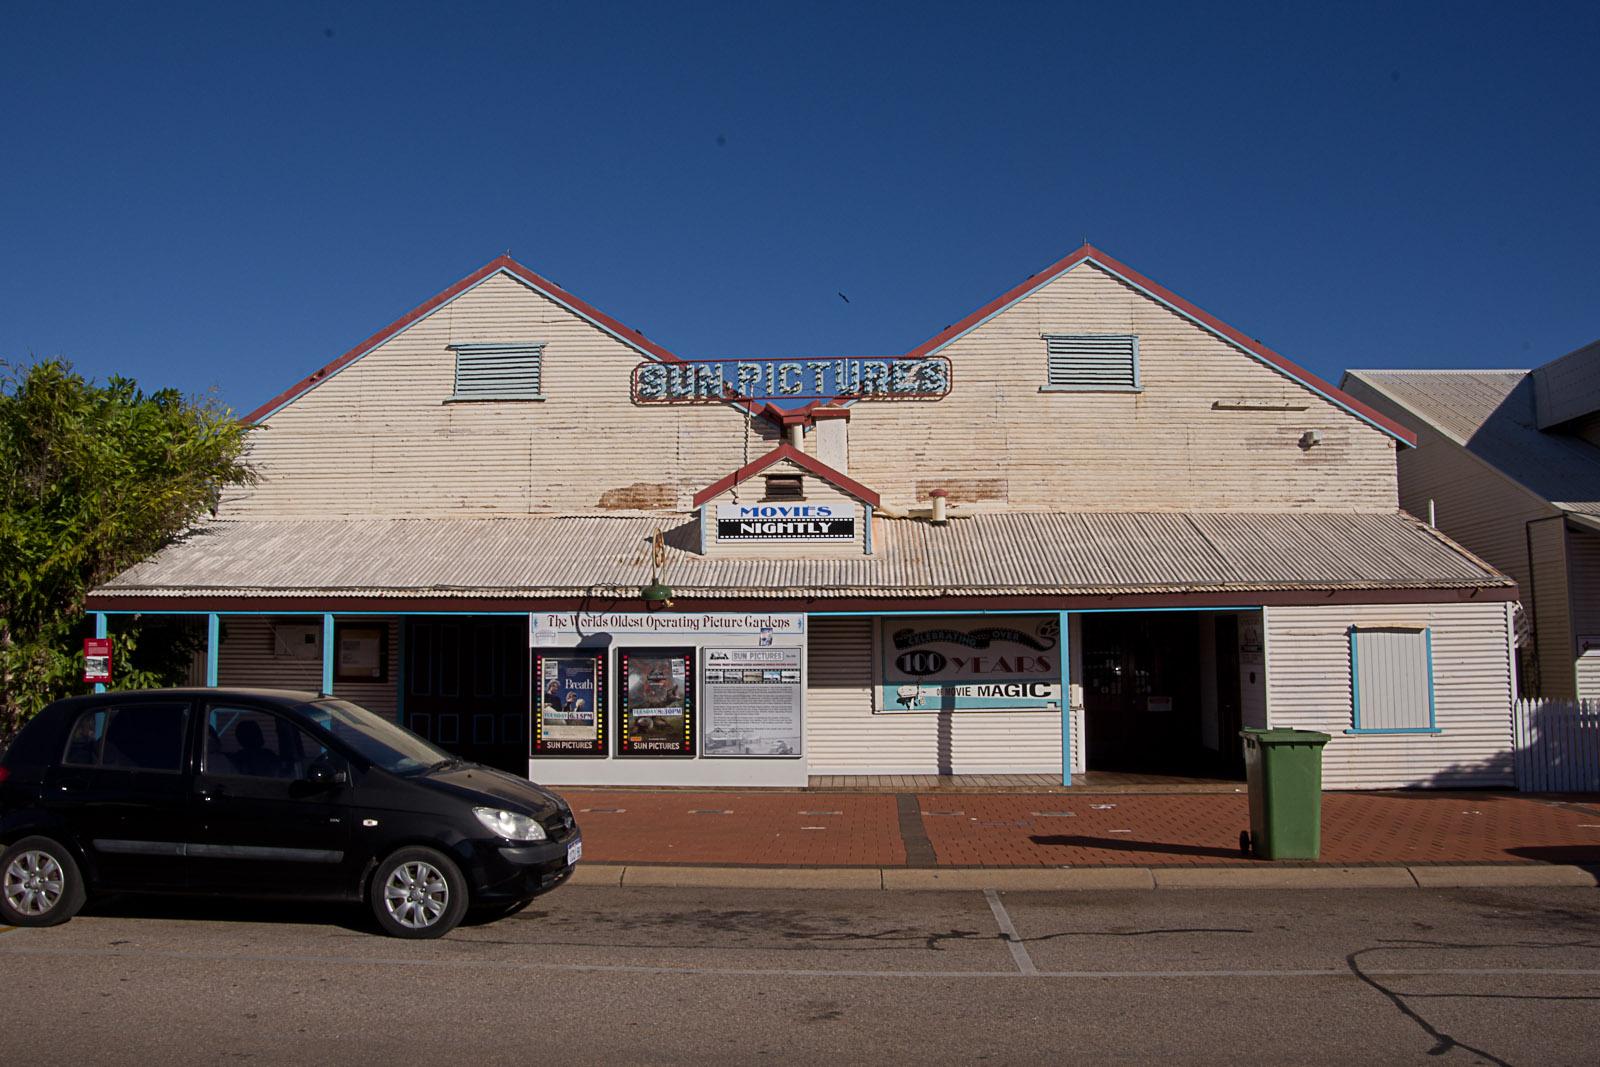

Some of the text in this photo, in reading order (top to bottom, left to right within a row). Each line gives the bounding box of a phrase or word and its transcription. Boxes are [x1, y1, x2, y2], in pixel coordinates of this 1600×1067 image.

[638, 357, 947, 398] SUN PICTURES
[740, 506, 832, 518] MOVIES
[740, 522, 832, 534] NIGHTLY
[547, 614, 567, 628] The
[611, 614, 643, 628] Oldest
[646, 614, 700, 630] Operating
[702, 614, 743, 628] Picture
[744, 614, 790, 629] Gardens
[908, 630, 1020, 647] CELEBRATING OVER
[733, 652, 748, 660] SUN
[749, 652, 783, 660] PICTURES
[901, 652, 1051, 673] 100 YEARS
[565, 679, 593, 690] Breath
[945, 686, 971, 697] MOVIE
[977, 682, 1052, 698] MAGIC
[633, 742, 680, 750] SUN PICTURES
